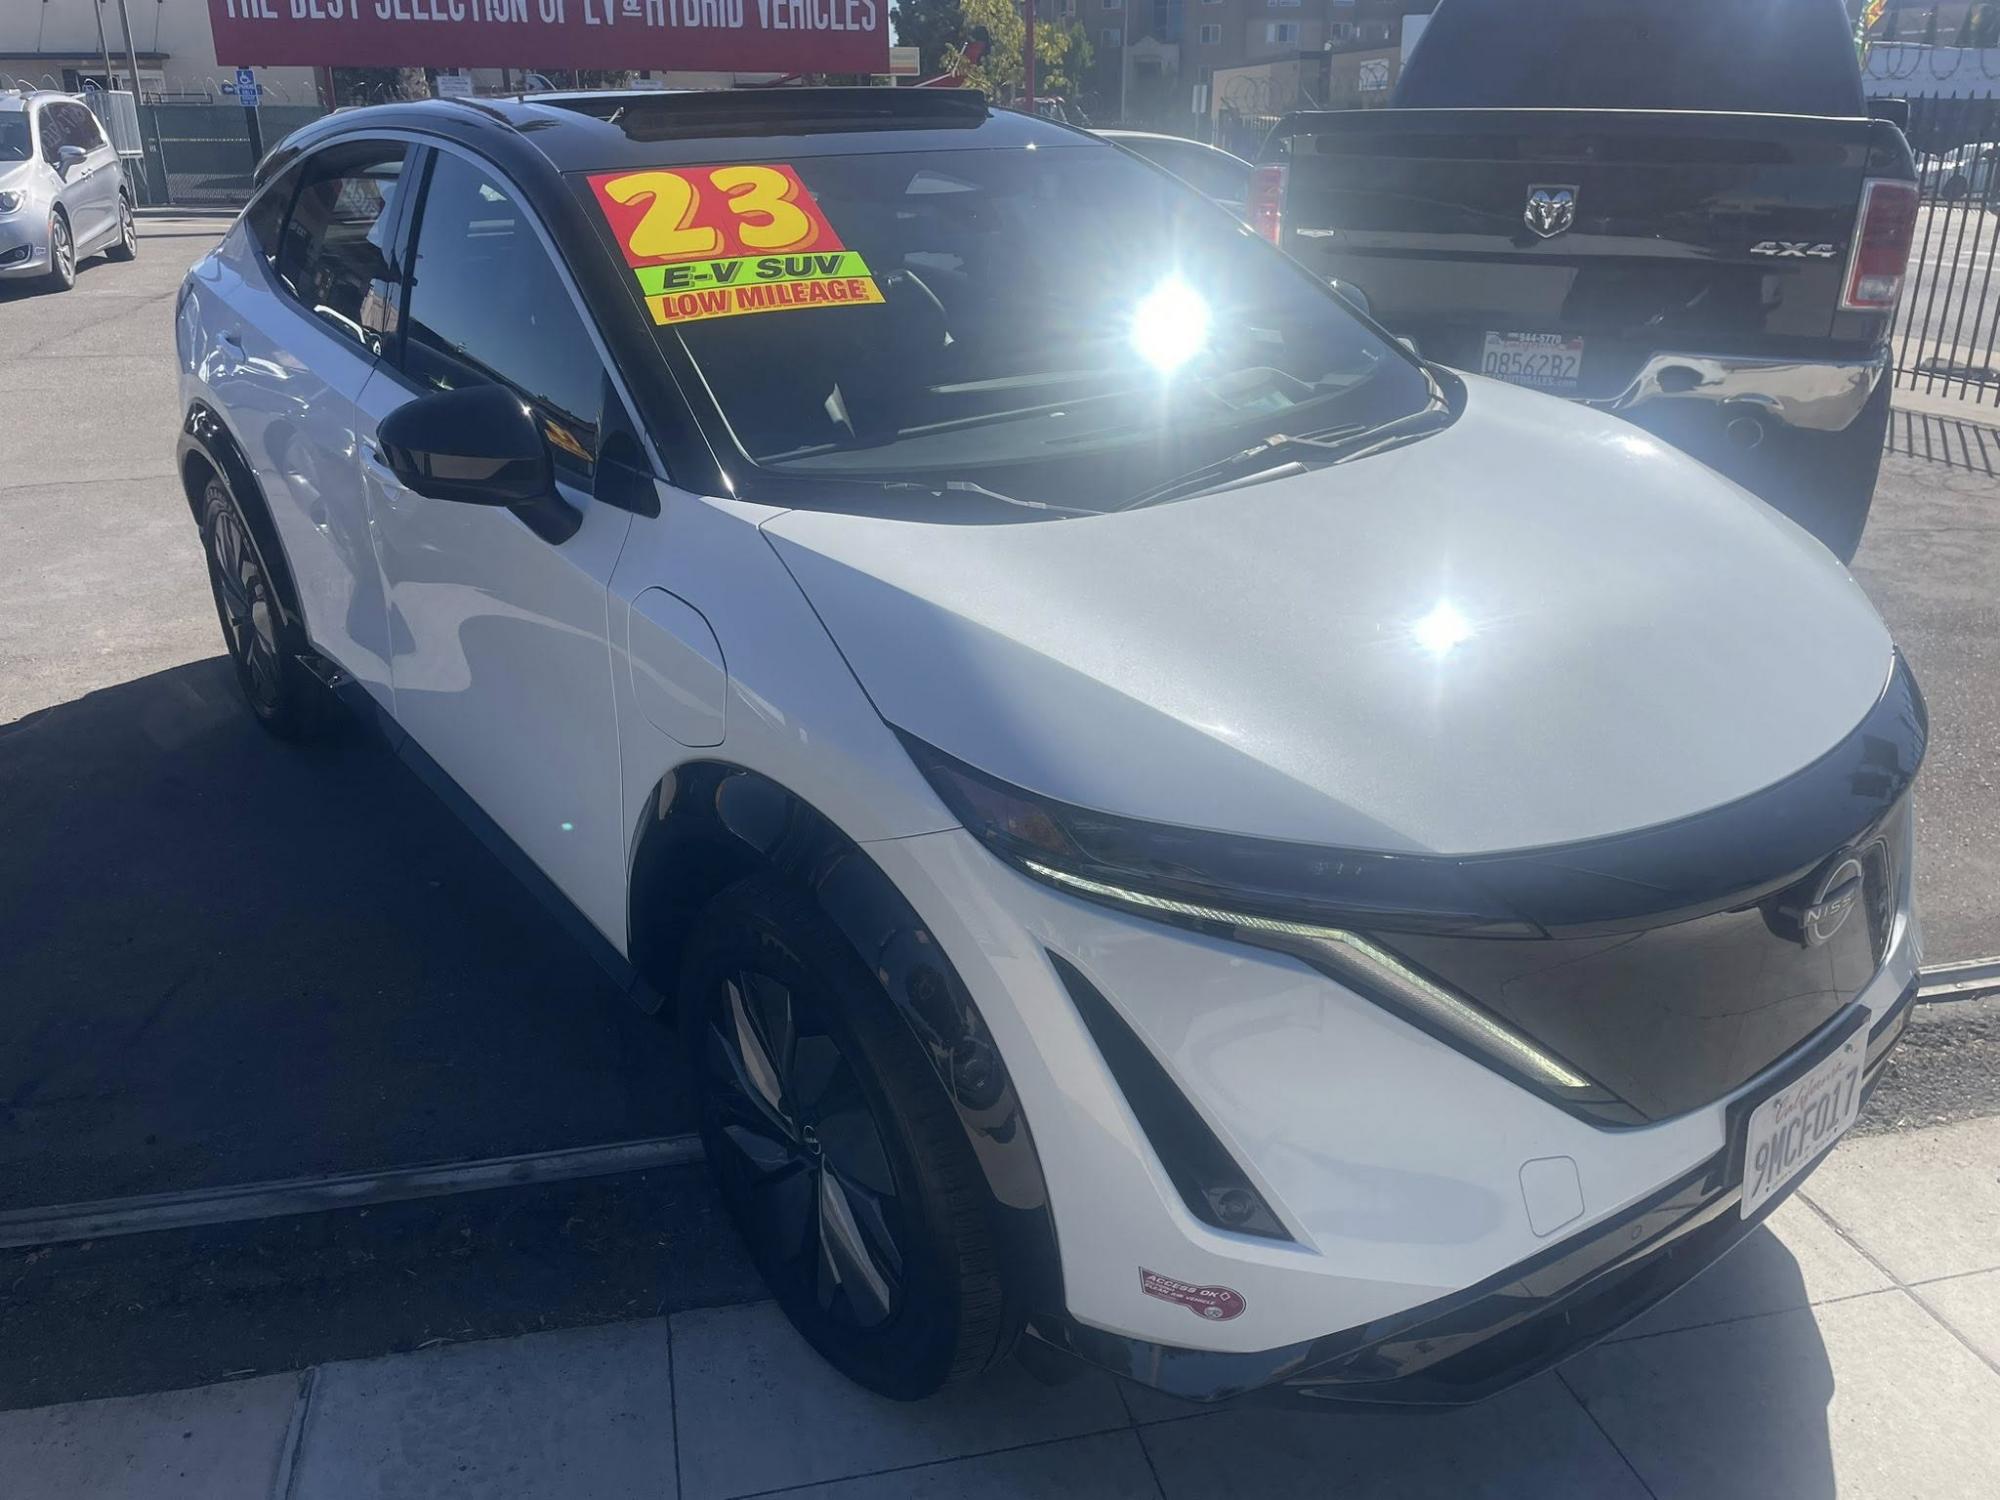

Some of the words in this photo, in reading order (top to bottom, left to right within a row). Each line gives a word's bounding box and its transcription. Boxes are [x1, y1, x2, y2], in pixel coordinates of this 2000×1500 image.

[757, 0, 876, 31] VEHICLES
[604, 166, 814, 258] 23
[663, 261, 741, 289] E-V
[755, 254, 843, 279] SUV
[661, 290, 730, 319] LOW
[735, 279, 868, 309] MILEAGE
[1485, 351, 1577, 377] 08562B2
[1752, 1065, 1859, 1198] 9MCF017
[1146, 1275, 1198, 1293] ACCESS
[1200, 1290, 1219, 1298] OK
